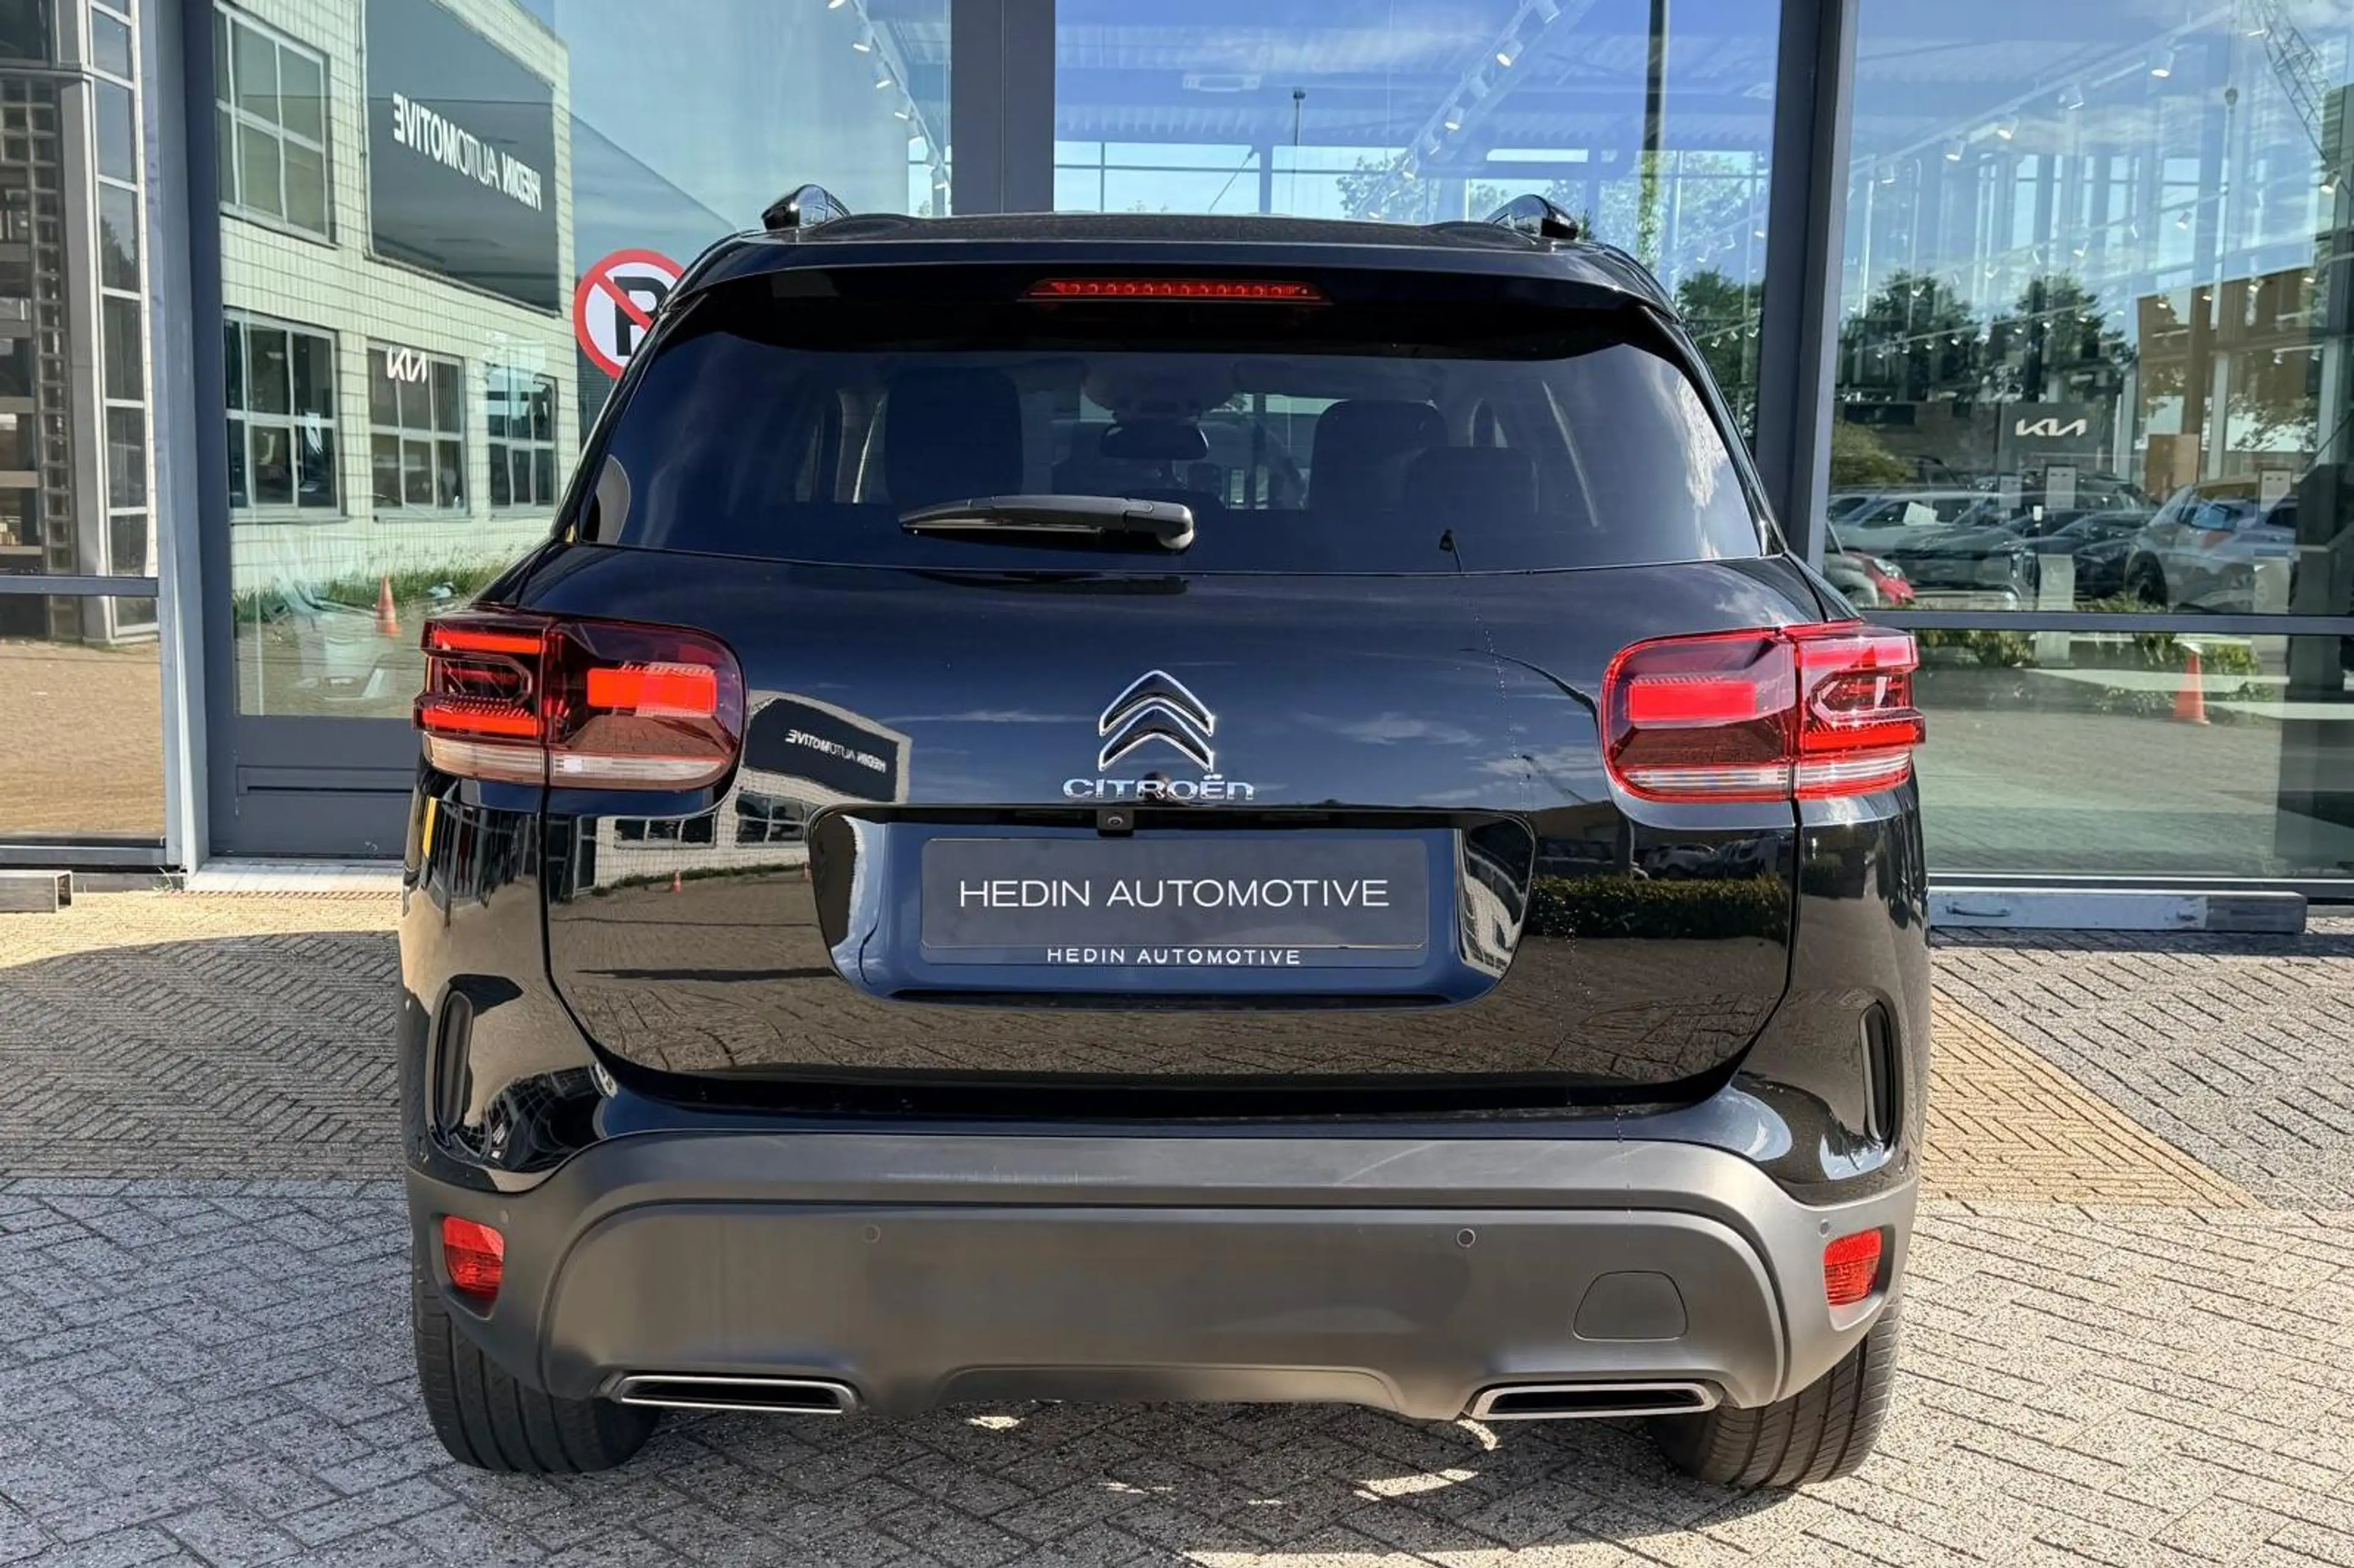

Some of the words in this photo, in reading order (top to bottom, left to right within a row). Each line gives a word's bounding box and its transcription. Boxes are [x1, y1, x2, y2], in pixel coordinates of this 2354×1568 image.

[2014, 417, 2087, 437] KIA
[960, 880, 1090, 907] HEDIN
[1107, 879, 1390, 907] AUTOMOTIVE
[1047, 948, 1124, 963] HEDIN
[1137, 949, 1300, 965] AUTOMOTIVE
